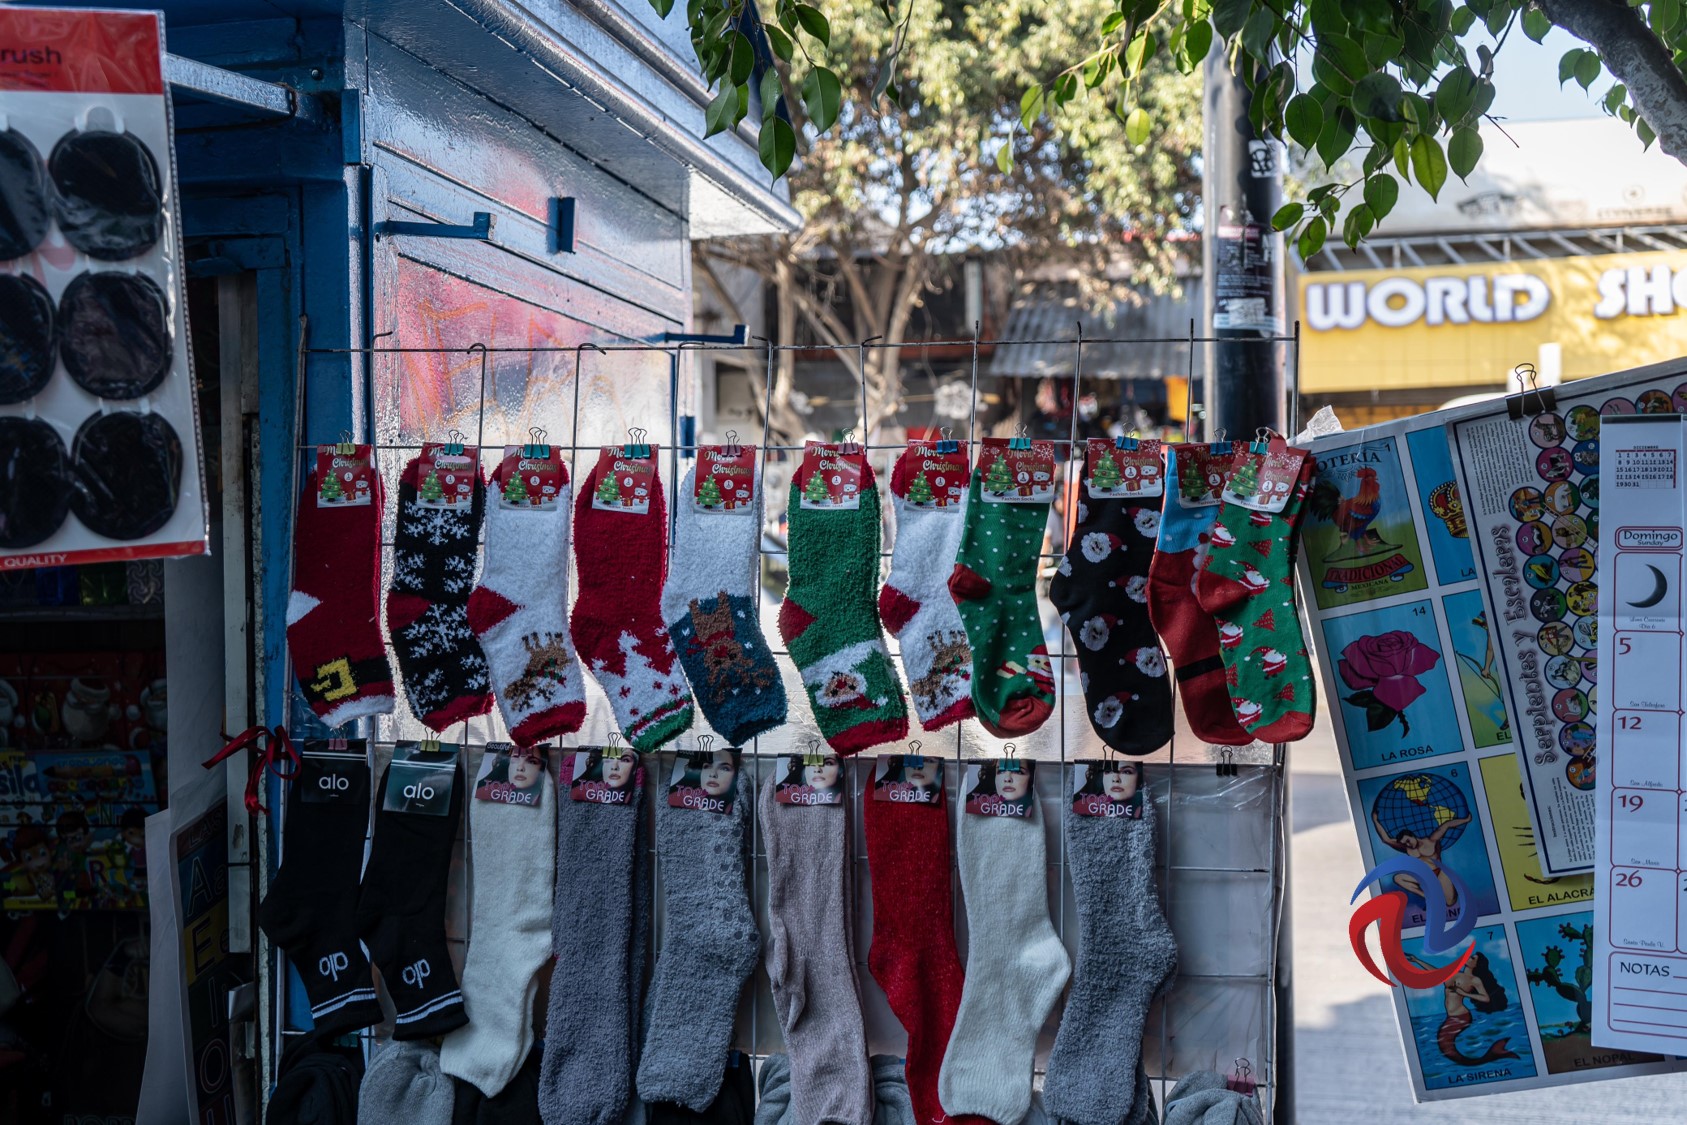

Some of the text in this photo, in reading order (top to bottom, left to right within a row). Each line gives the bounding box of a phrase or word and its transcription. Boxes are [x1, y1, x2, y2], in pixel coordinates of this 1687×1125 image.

[1306, 264, 1687, 330] WORLD SH
[1623, 530, 1678, 543] Domingo
[1637, 539, 1664, 547] Sunday
[3, 553, 68, 567] QUALITY
[1329, 557, 1407, 581] TRADICIONAL
[1461, 567, 1476, 578] LA
[1491, 527, 1526, 626] Escaleras
[1351, 579, 1389, 590] MEXICANA
[1413, 606, 1426, 617] 14
[1618, 637, 1632, 655] 5
[1518, 651, 1556, 766] Serpientes
[1617, 716, 1642, 730] 12
[1496, 731, 1512, 741] EL
[1381, 745, 1433, 761] LA ROSA
[318, 773, 349, 790] alo
[403, 783, 435, 800] alo
[490, 789, 532, 804] GRADE
[585, 789, 625, 802] GRADE
[790, 792, 833, 804] GRADE
[889, 789, 931, 801] GRADE
[683, 796, 725, 812] GRADE
[980, 802, 1024, 816] GRADE
[1088, 802, 1133, 816] GRADE
[1617, 795, 1644, 813] 19
[1615, 870, 1643, 888] 26
[1528, 895, 1544, 905] EL
[1412, 914, 1426, 923] EL
[1487, 931, 1494, 940] 7
[1620, 961, 1670, 977] NOTAS
[1574, 1052, 1635, 1067] EL NOPAL
[1448, 1067, 1512, 1084] LA SIRENA
